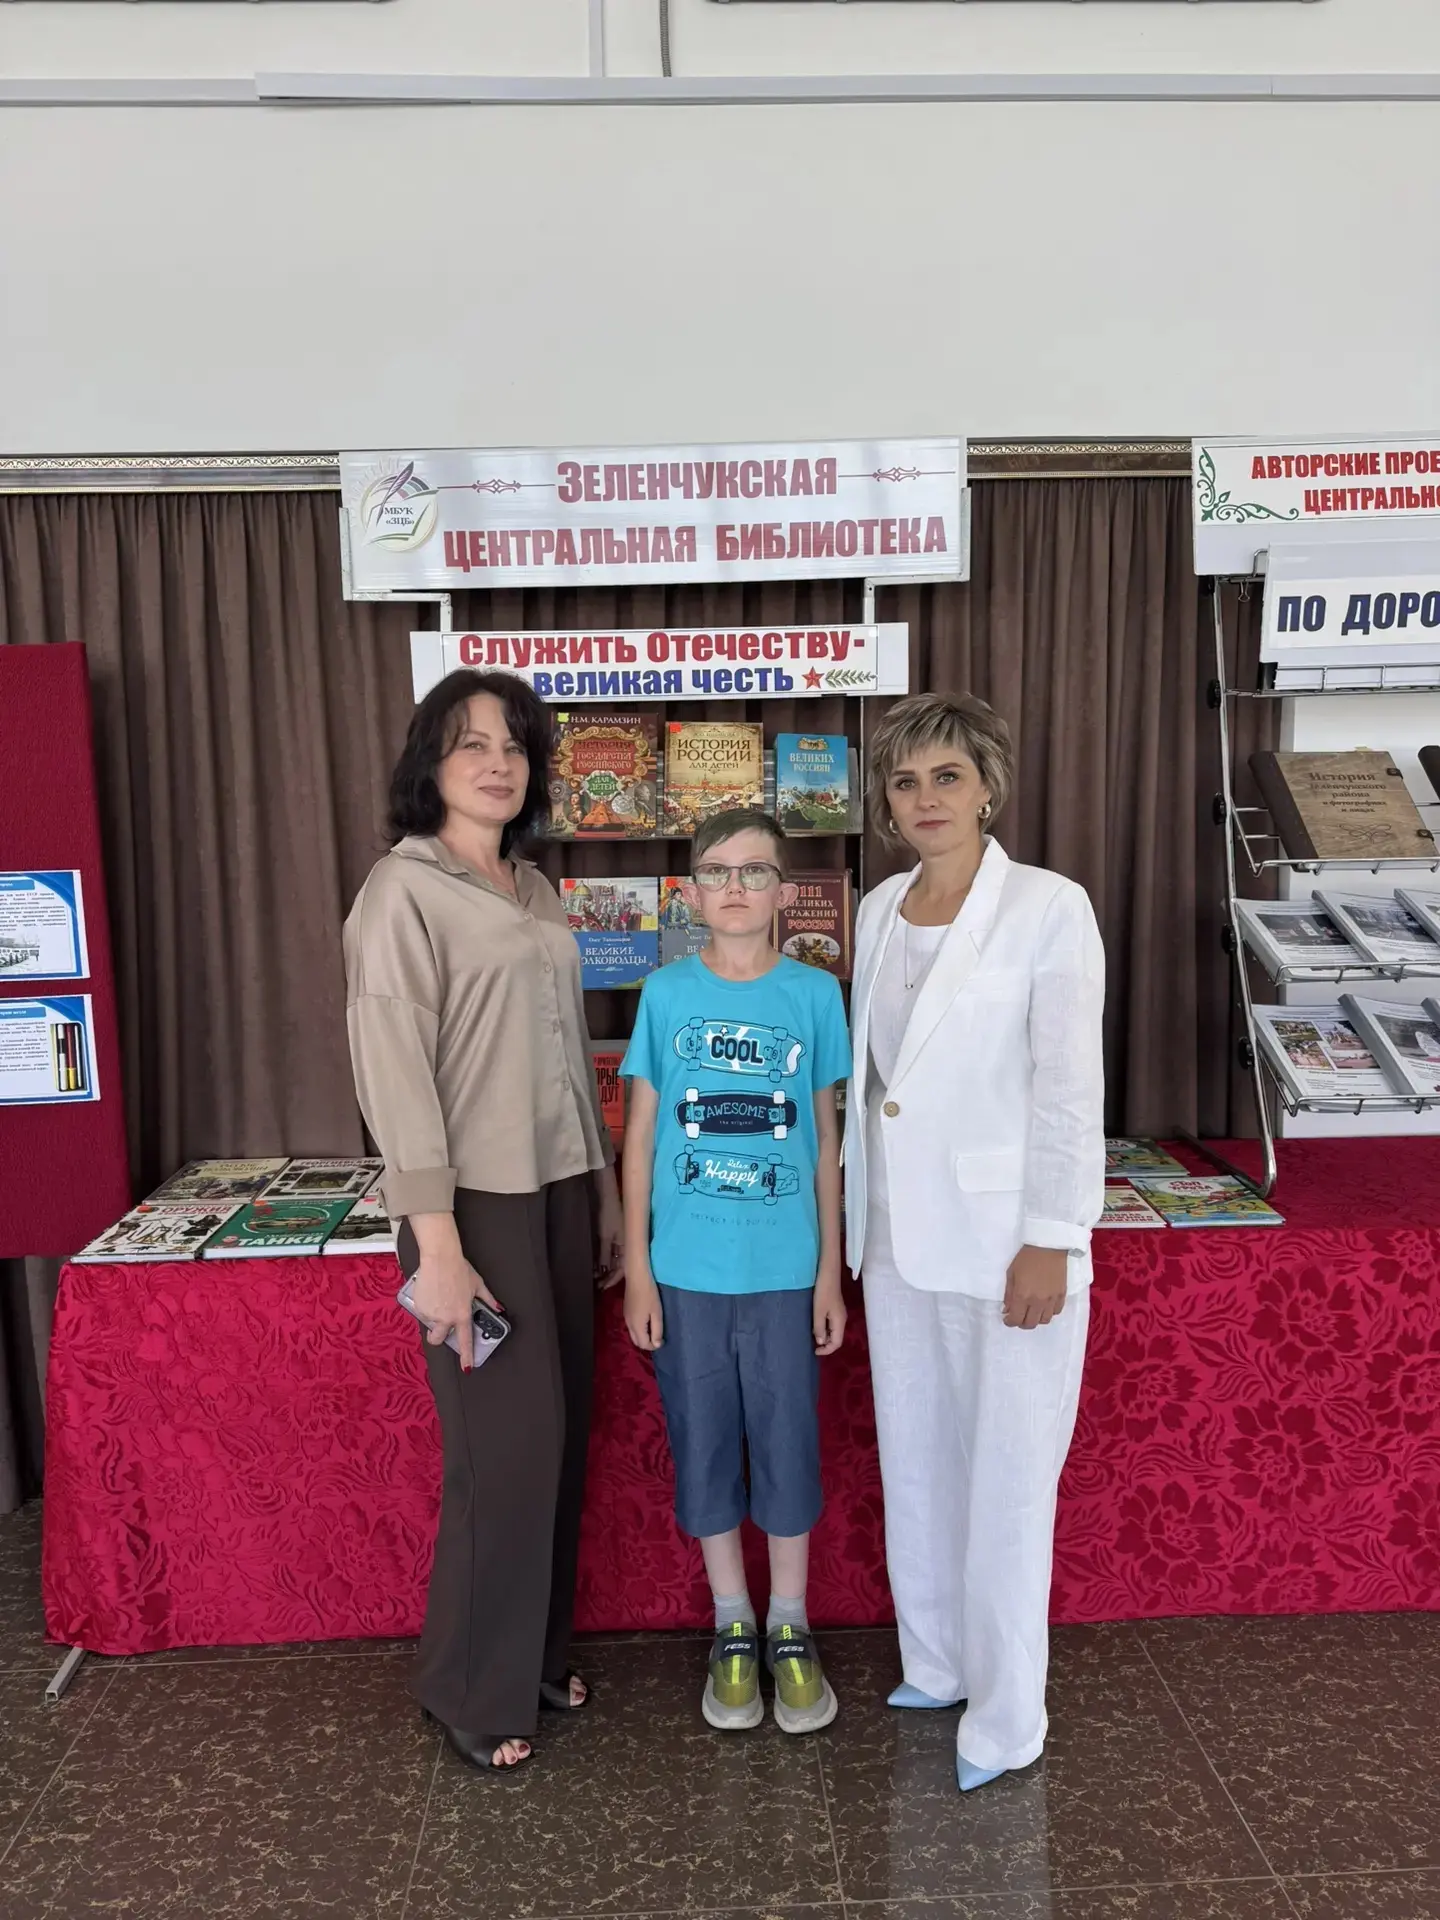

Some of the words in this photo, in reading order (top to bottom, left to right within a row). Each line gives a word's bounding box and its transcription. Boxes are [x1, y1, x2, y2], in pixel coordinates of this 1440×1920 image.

[1251, 453, 1380, 479] АВТОРСКИЕ
[557, 457, 837, 503] ЗЕЛЕНЧУКСКАЯ
[384, 507, 414, 515] МБУК
[443, 526, 696, 573] ЦЕНТРАЛЬНАЯ
[717, 516, 947, 562] БИБЛИОТЕКА
[1277, 595, 1326, 632] ПО
[591, 716, 641, 724] КАРАМЗИН
[678, 739, 751, 750] ИСТОРИЯ
[677, 749, 752, 761] РОССИИ
[789, 752, 835, 763] ВЕЛИКИХ
[793, 763, 831, 772] РОССИЯН
[1308, 772, 1376, 782] История
[784, 908, 838, 917] СРАЖЕНИЙ
[787, 919, 835, 930] РОССИИ
[585, 946, 635, 955] ВЕЛИКИЕ
[710, 1034, 764, 1064] COOL
[706, 1102, 767, 1119] AWESOME
[704, 1159, 759, 1187] Happy
[238, 1236, 324, 1246] ТАНКИ
